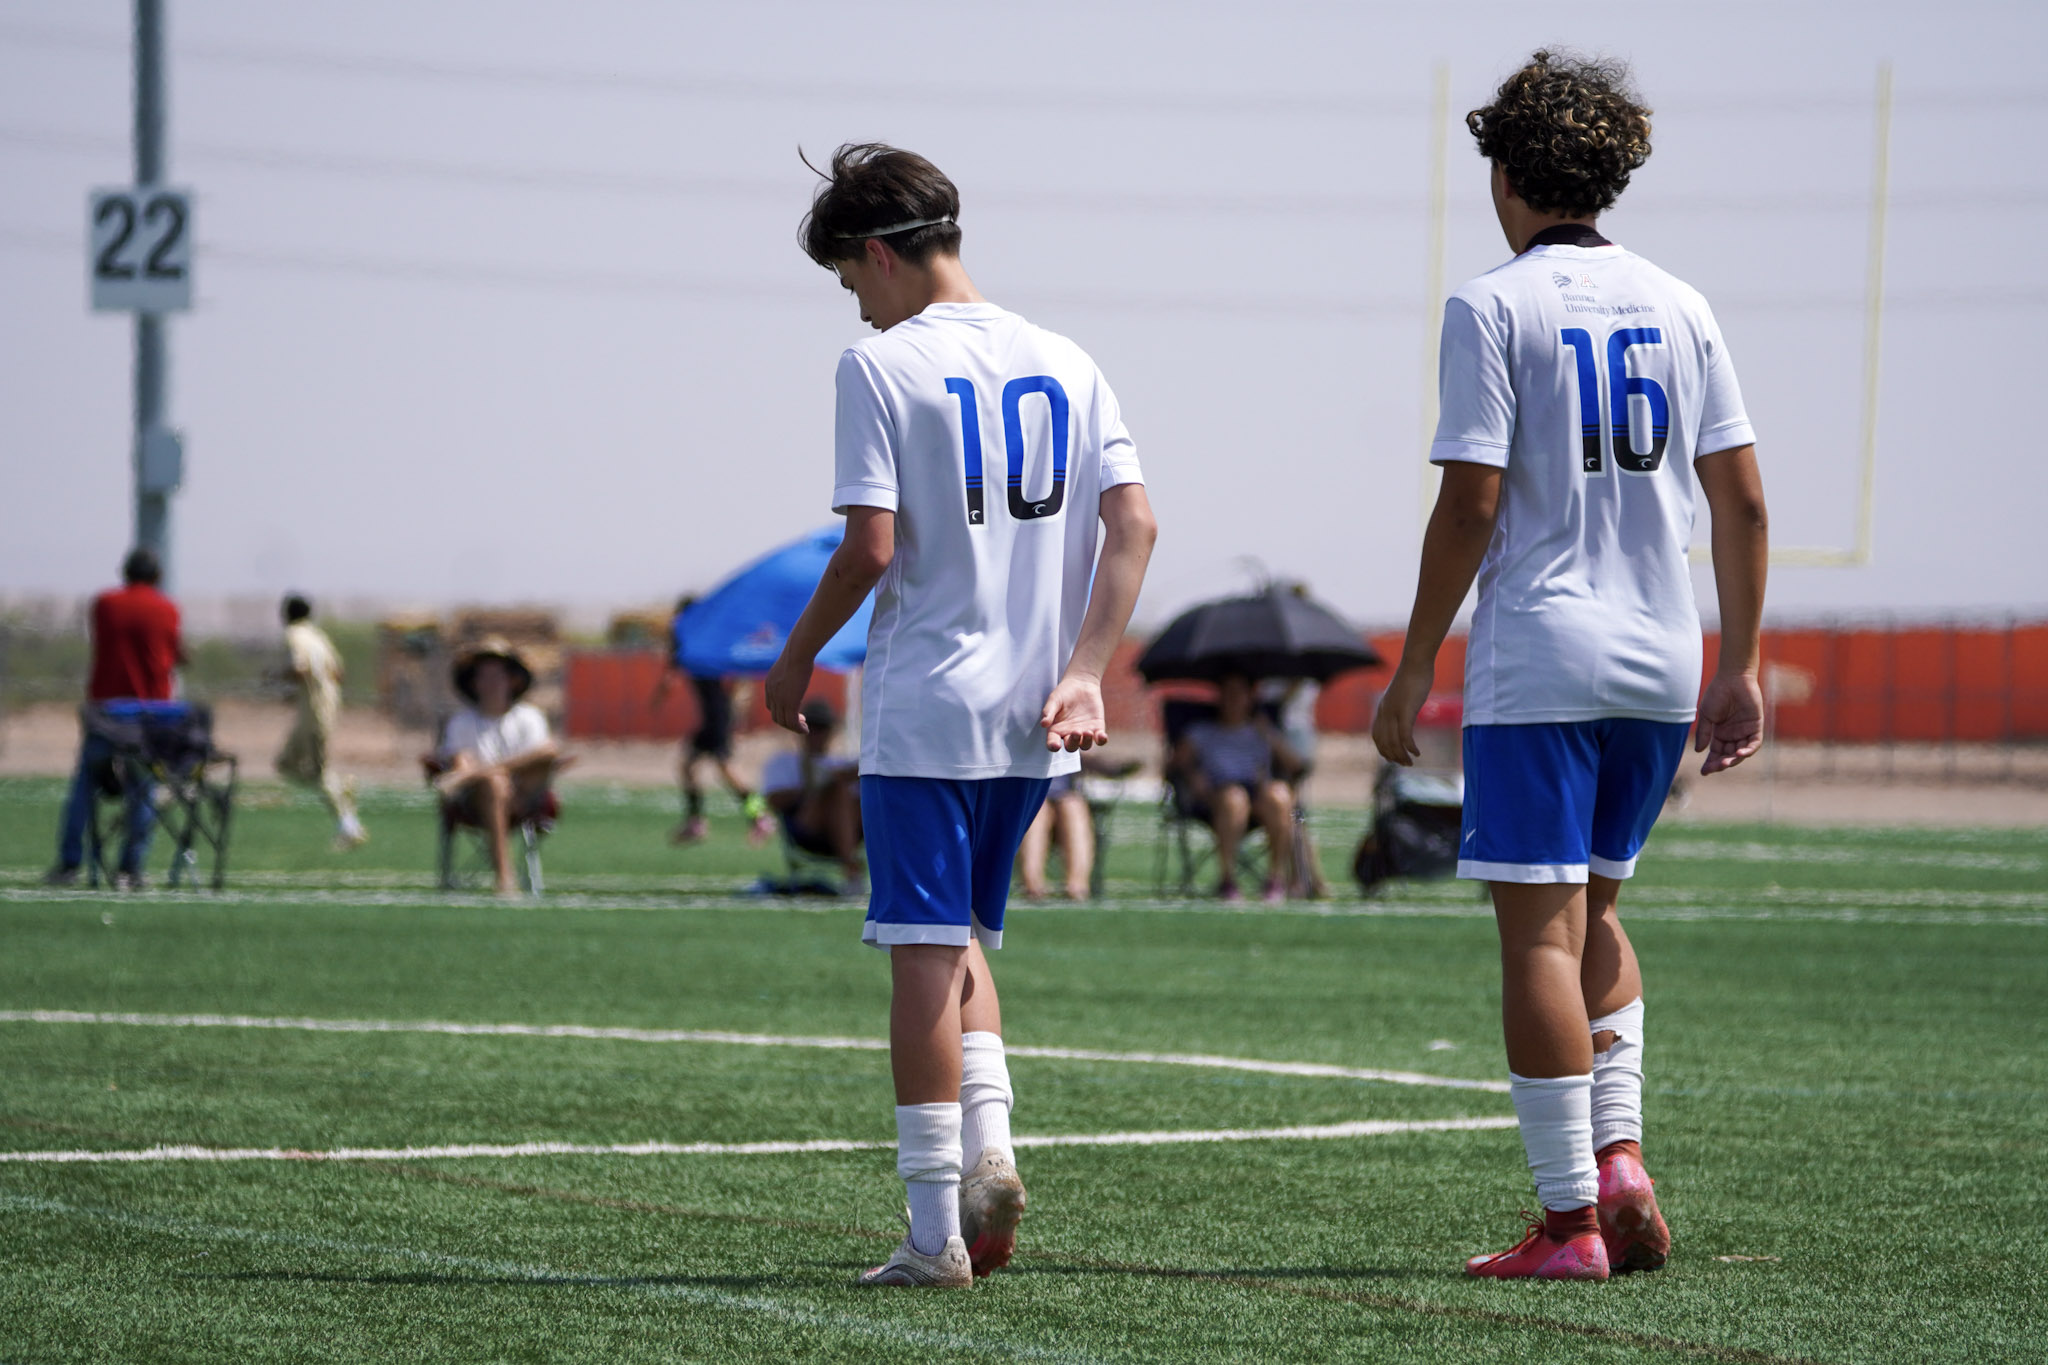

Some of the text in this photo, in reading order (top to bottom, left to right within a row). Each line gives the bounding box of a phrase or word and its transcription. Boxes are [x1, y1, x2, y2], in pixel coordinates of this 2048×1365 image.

[95, 194, 186, 280] 22
[1565, 303, 1656, 317] University Medicine
[1580, 274, 1598, 288] A
[1560, 327, 1670, 472] 16
[944, 375, 1069, 525] 10
